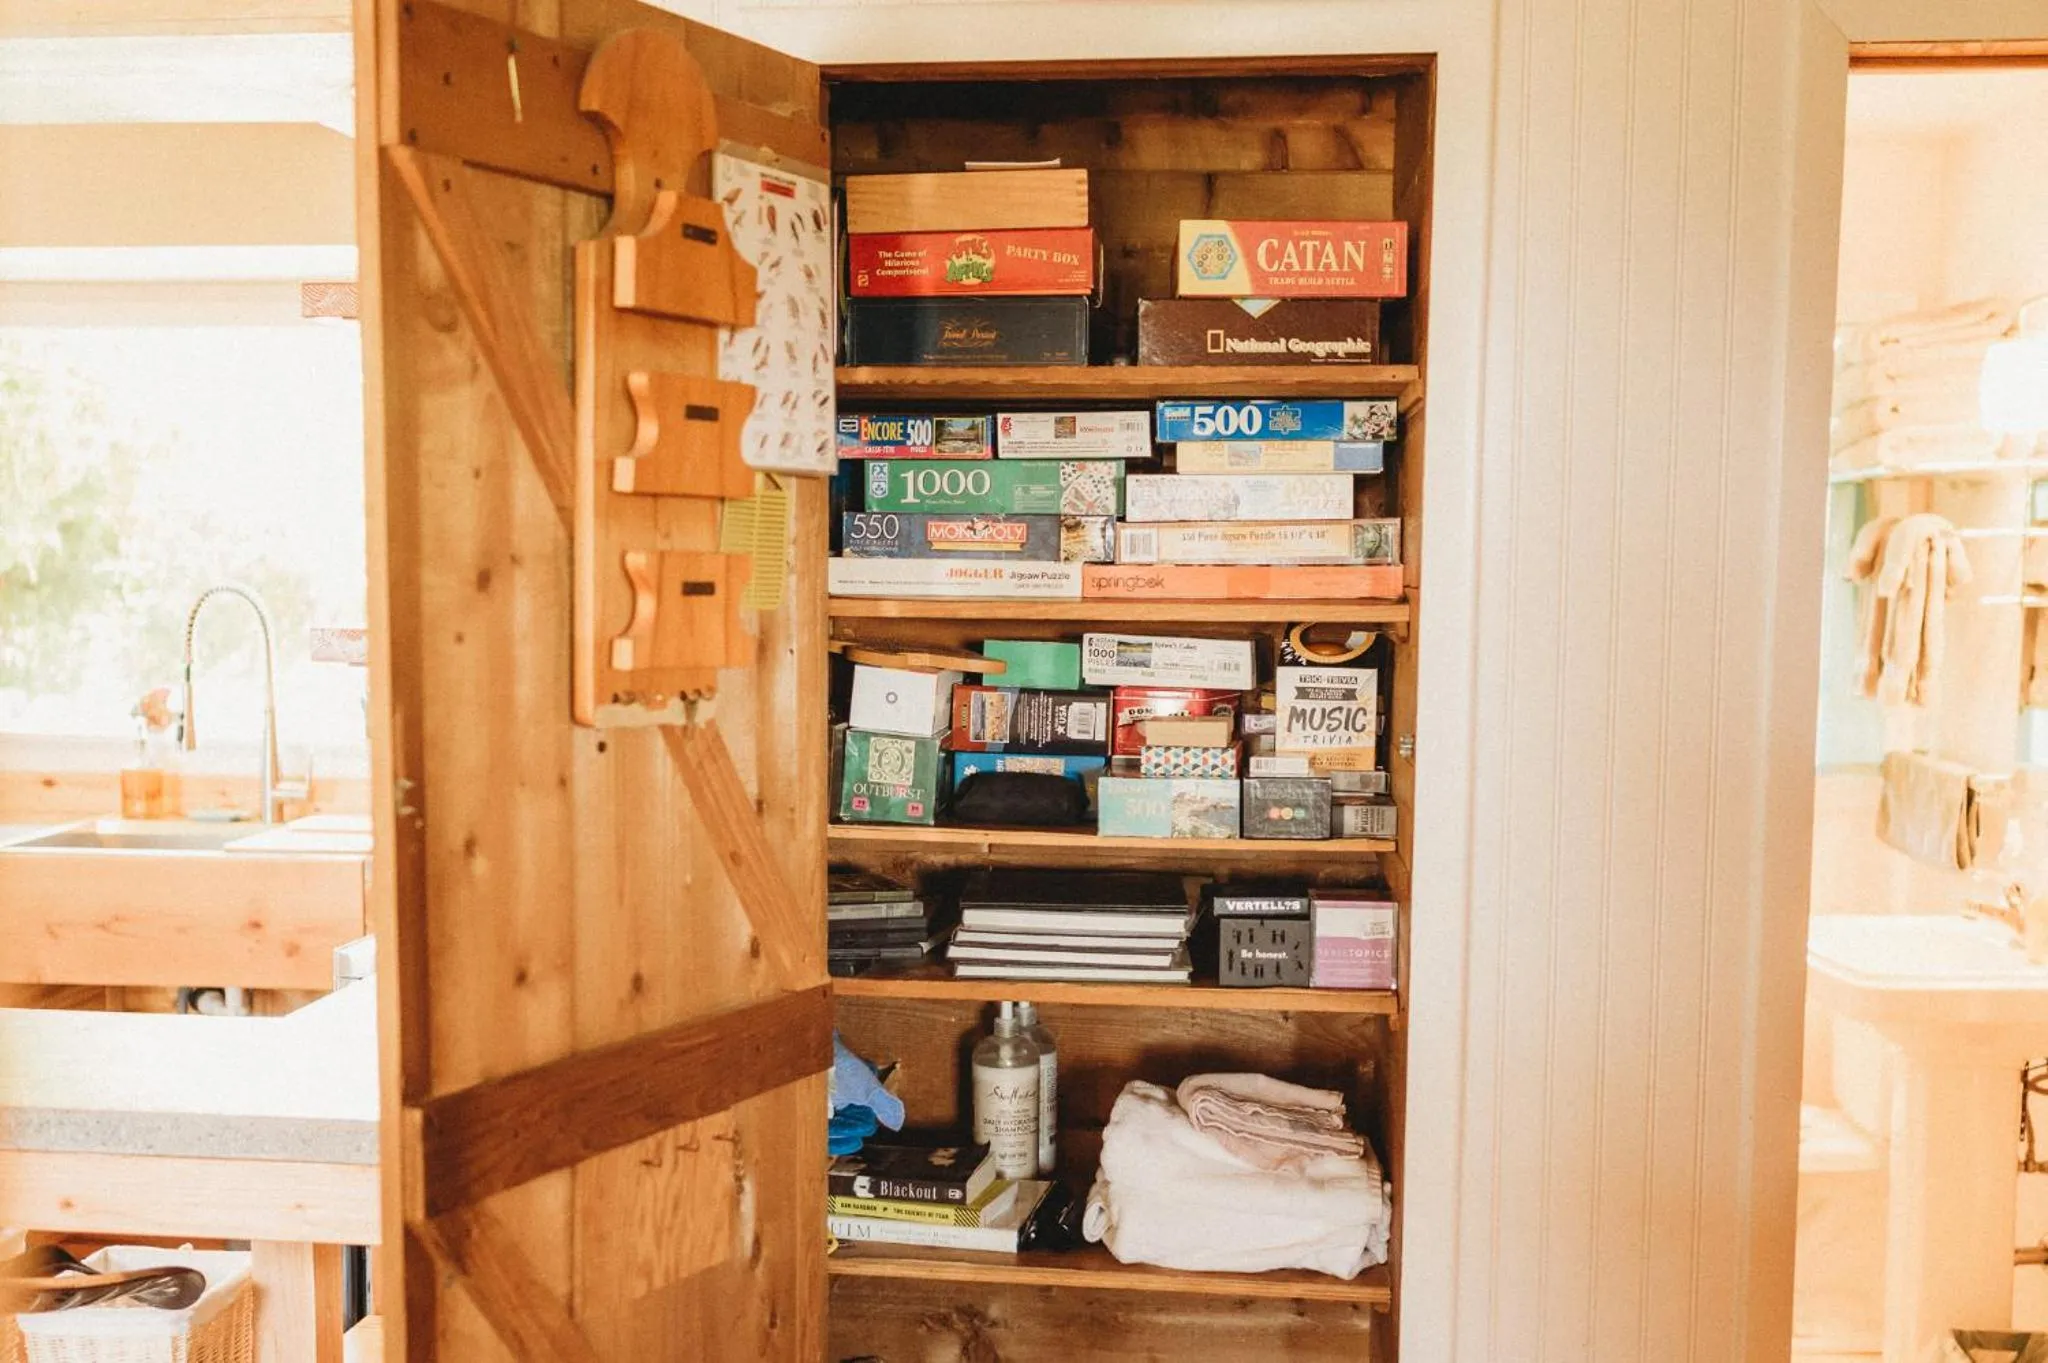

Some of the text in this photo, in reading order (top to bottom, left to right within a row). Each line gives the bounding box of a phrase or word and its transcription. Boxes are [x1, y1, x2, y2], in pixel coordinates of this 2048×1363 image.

[877, 250, 892, 258] The
[894, 250, 917, 258] Game
[1006, 244, 1080, 265] PARTY BOX
[1257, 238, 1366, 273] CATAN
[1226, 337, 1372, 357] National Geographic
[1193, 405, 1262, 436] 500
[861, 418, 932, 446] ENCORE 500
[900, 469, 991, 504] 1000
[850, 514, 899, 539] 550
[930, 522, 1026, 541] MONOPOLY
[1009, 571, 1039, 582] Jigsaw
[1041, 571, 1071, 581] Puzzle
[1088, 648, 1115, 658] 1000
[1058, 704, 1068, 728] USA
[1287, 705, 1368, 733] MUSIC
[1303, 735, 1353, 745] TRIVIA
[853, 783, 925, 800] OUTBURST
[1240, 949, 1289, 959] Be honest.
[880, 1180, 938, 1199] Blackout
